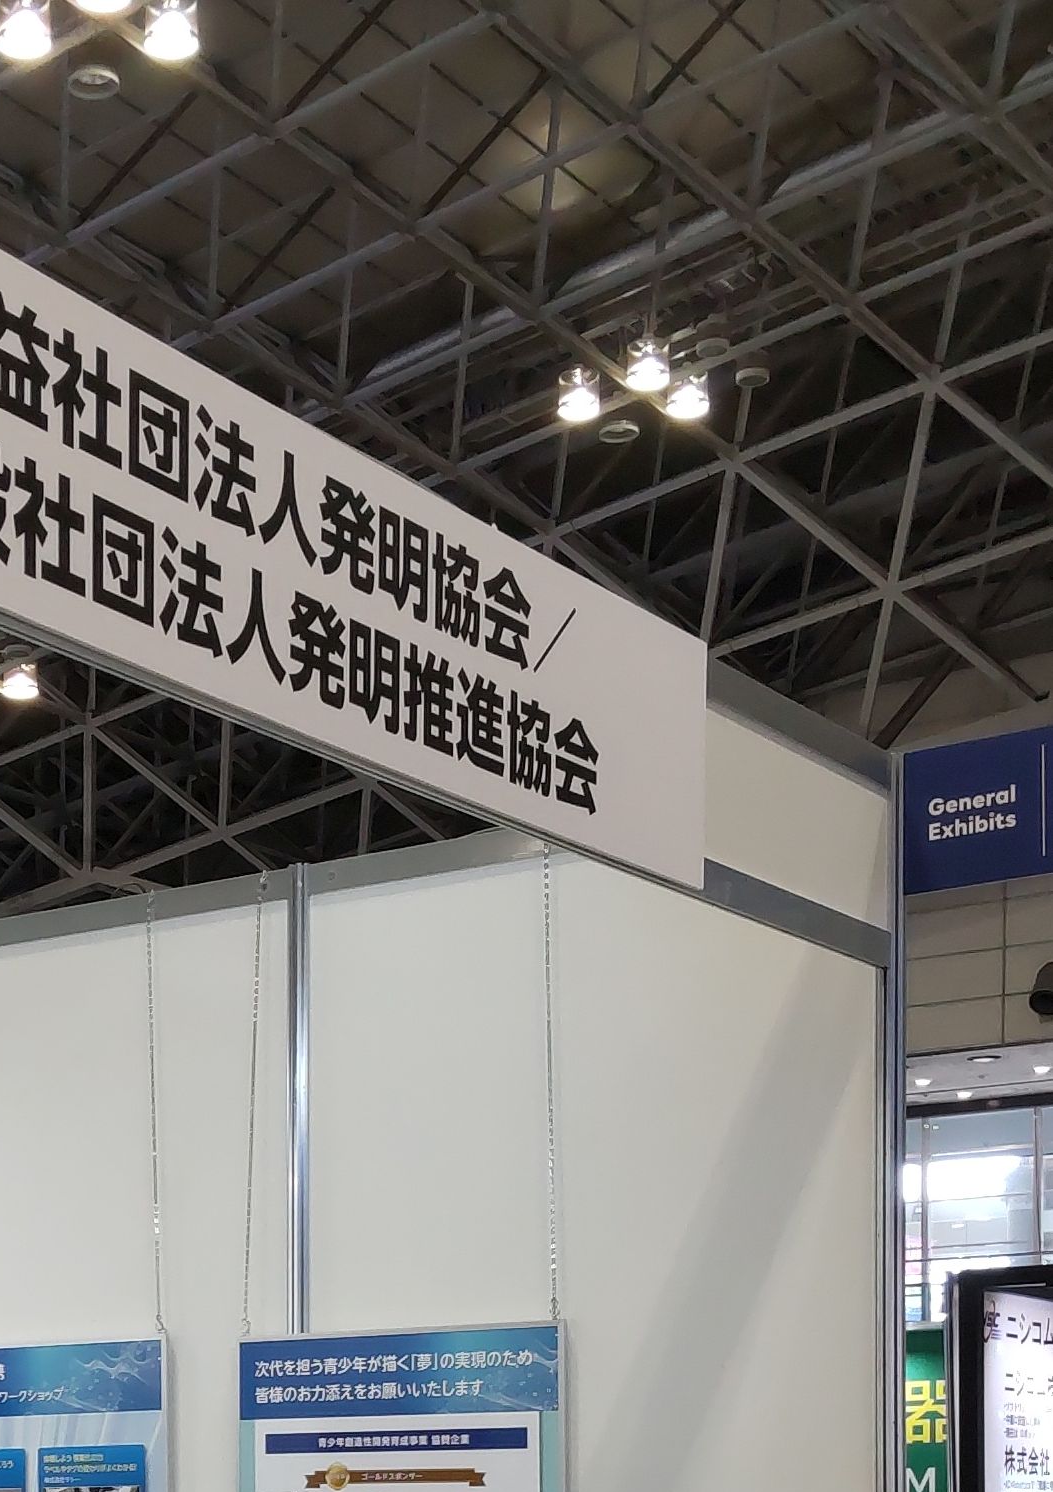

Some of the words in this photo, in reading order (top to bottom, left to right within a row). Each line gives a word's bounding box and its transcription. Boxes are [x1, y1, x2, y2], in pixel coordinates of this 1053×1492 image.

[928, 784, 1016, 816] General
[928, 812, 1017, 841] Exhibits
[254, 1349, 533, 1378] 次代を担う青少年が描く「夢」の実現のため
[254, 1378, 484, 1404] 皆様のお力添えをお願いいたします
[1005, 1444, 1051, 1476] 株式会社
